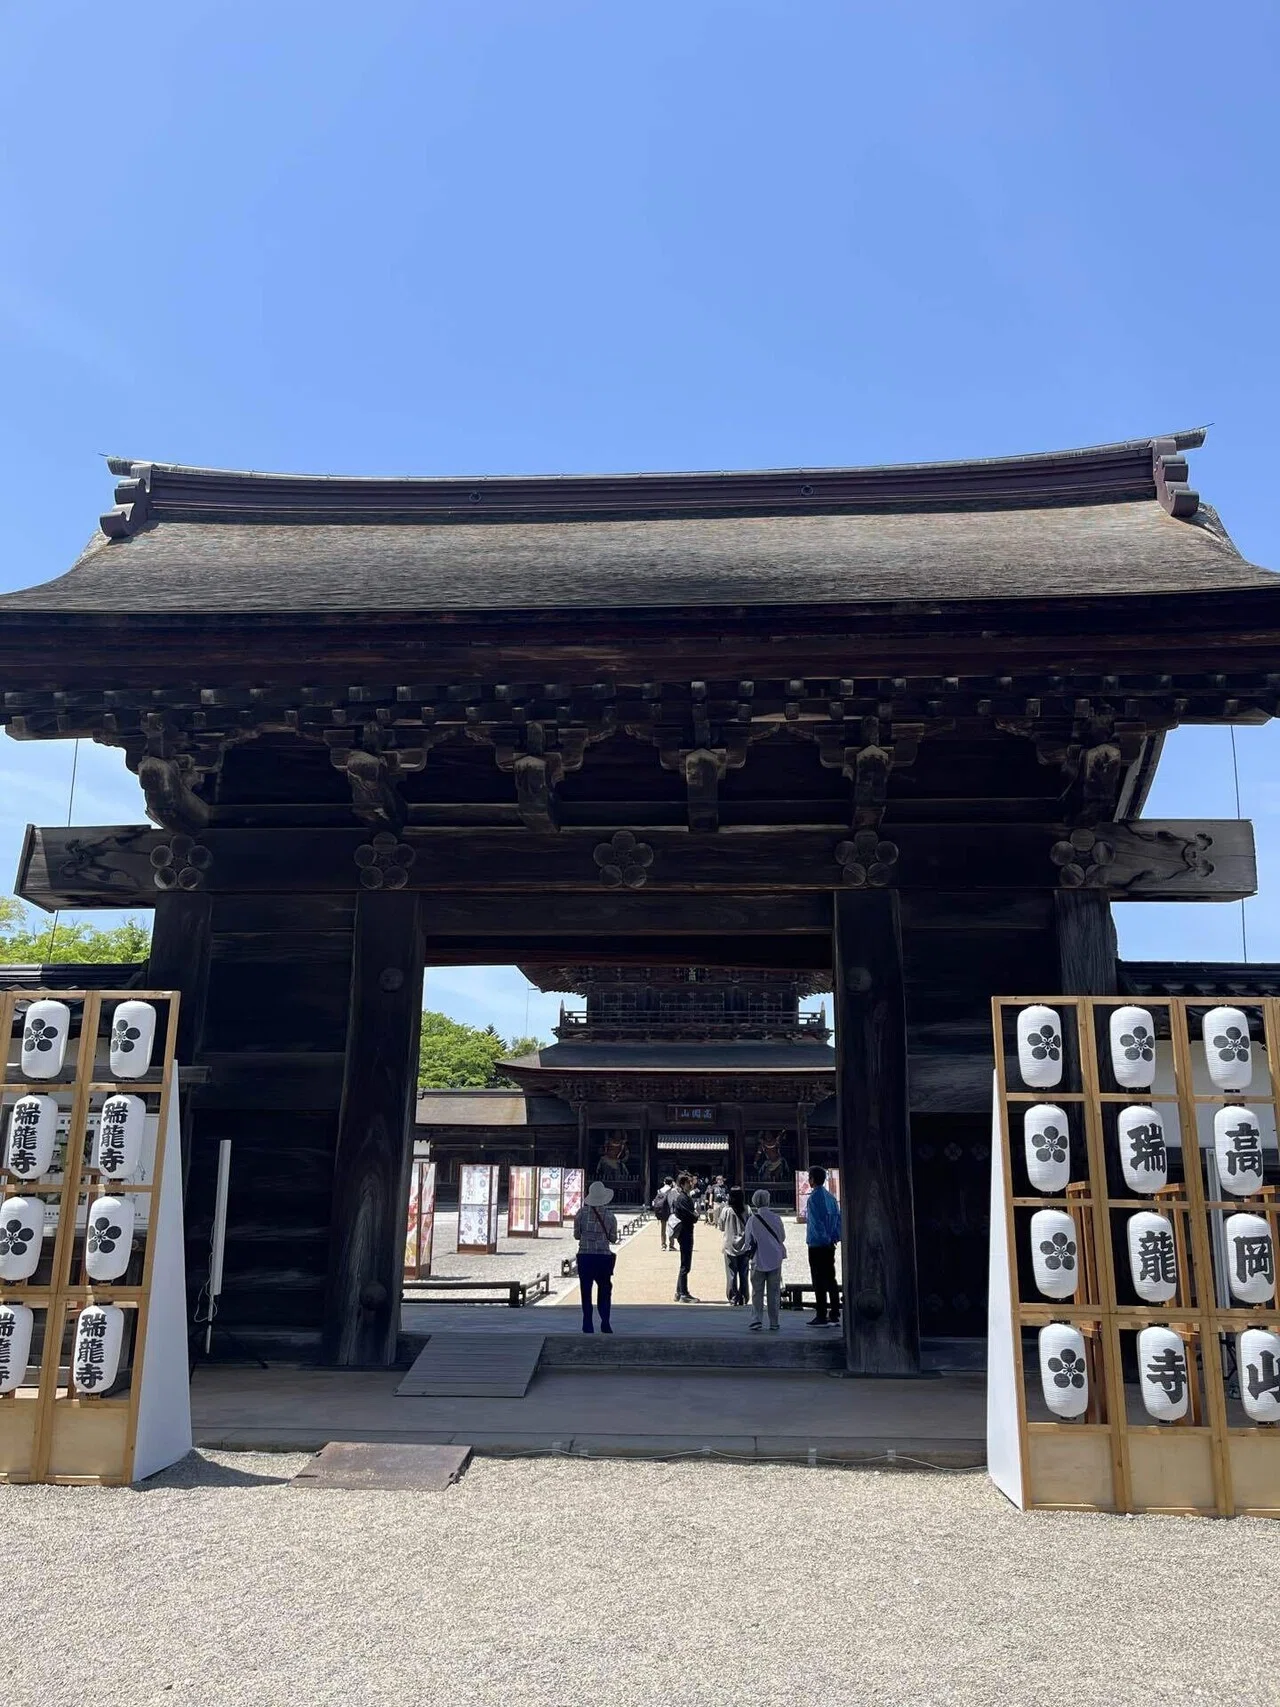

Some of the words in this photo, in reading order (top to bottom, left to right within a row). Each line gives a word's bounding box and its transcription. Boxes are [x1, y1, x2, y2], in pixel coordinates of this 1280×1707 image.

[10, 1101, 41, 1174] 瑞龍寺
[99, 1101, 129, 1173] 瑞龍寺
[1126, 1122, 1166, 1174] 瑞
[1224, 1122, 1263, 1178] 高
[1138, 1230, 1177, 1284] 龍
[1233, 1234, 1275, 1285] 岡
[76, 1313, 108, 1389] 瑞龍寺
[1146, 1348, 1187, 1405] 寺
[1246, 1350, 1280, 1403] 山
